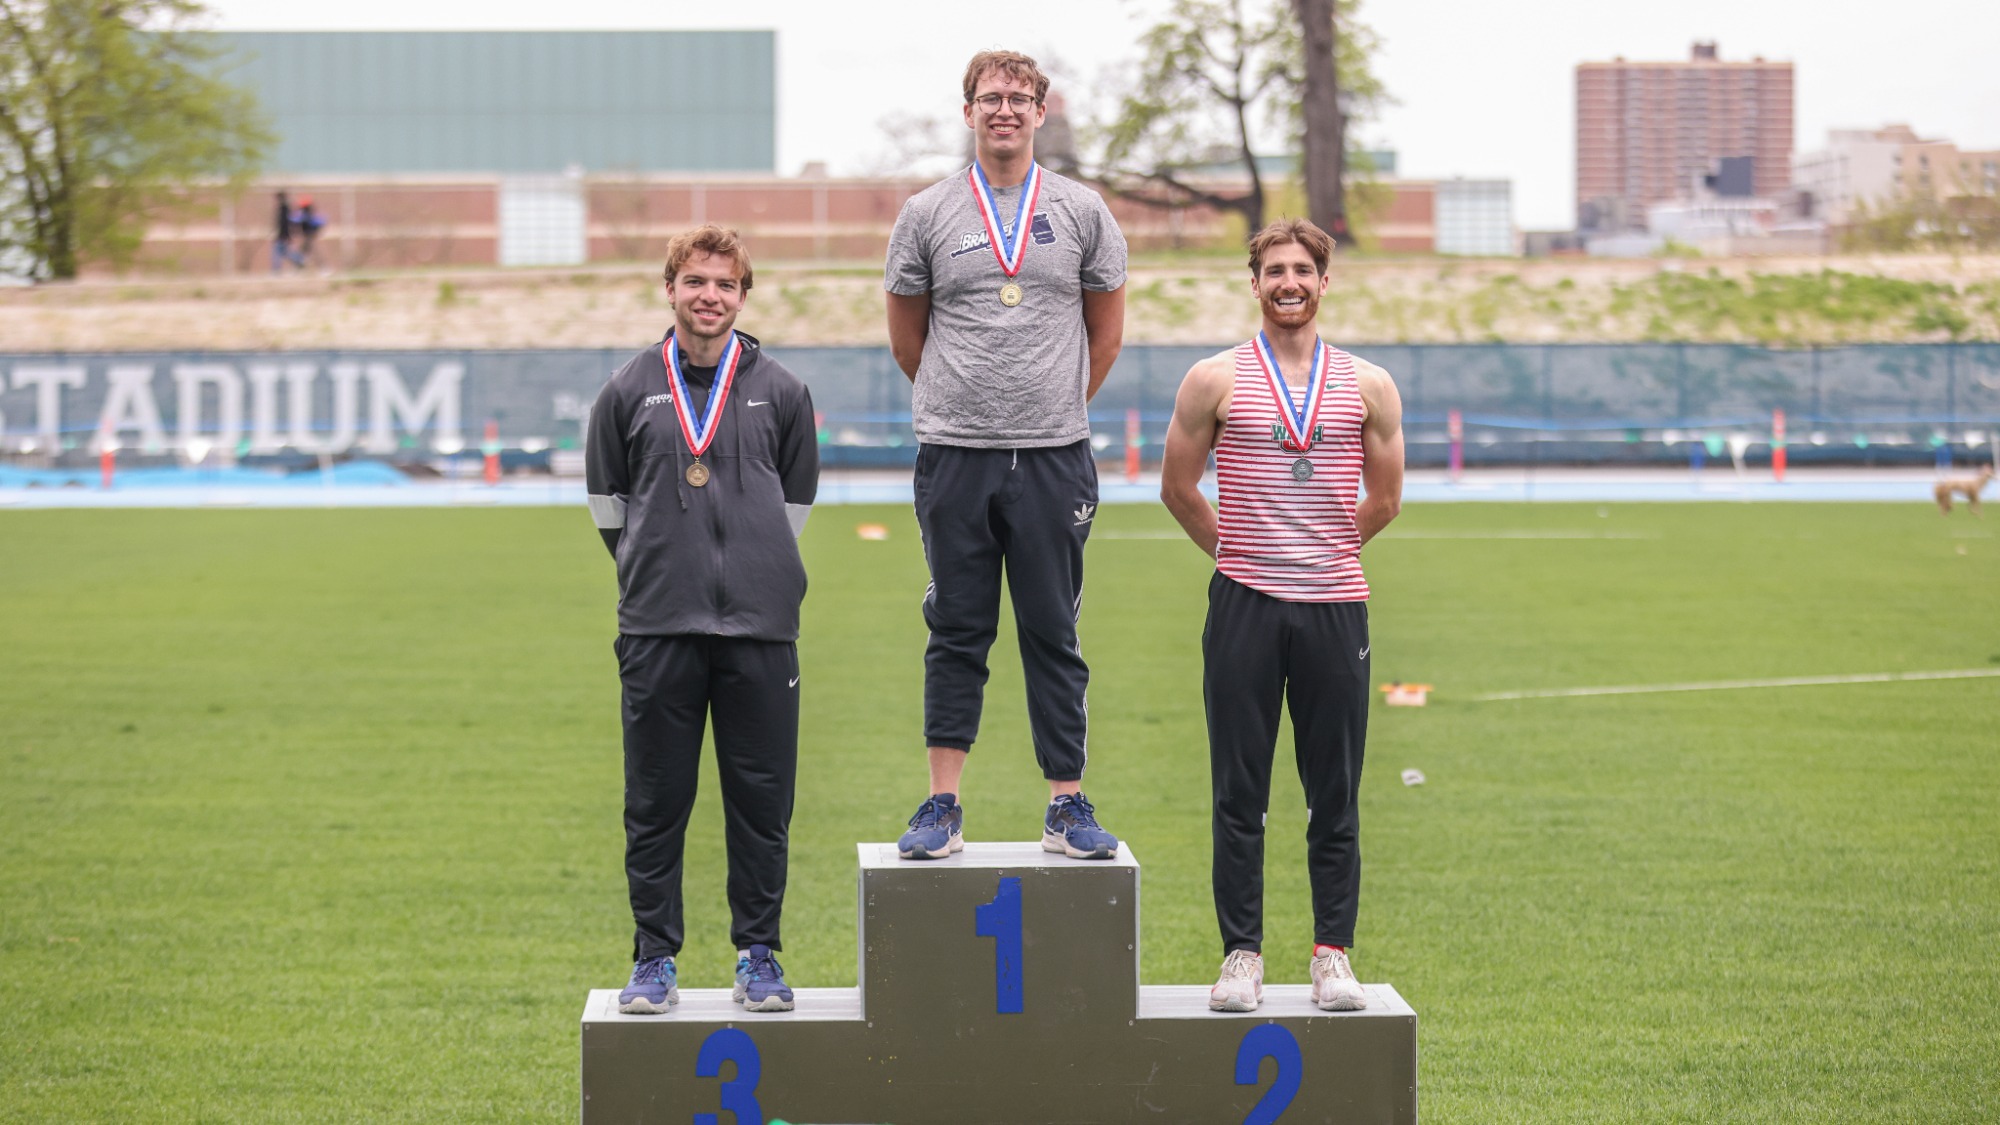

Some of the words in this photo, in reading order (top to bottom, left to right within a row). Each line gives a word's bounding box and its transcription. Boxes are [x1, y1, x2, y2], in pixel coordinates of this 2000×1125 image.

[0, 364, 465, 456] TADIUM
[1271, 424, 1323, 442] WH
[976, 877, 1024, 1014] 1
[693, 1028, 763, 1125] 3
[1235, 1023, 1303, 1125] 2
